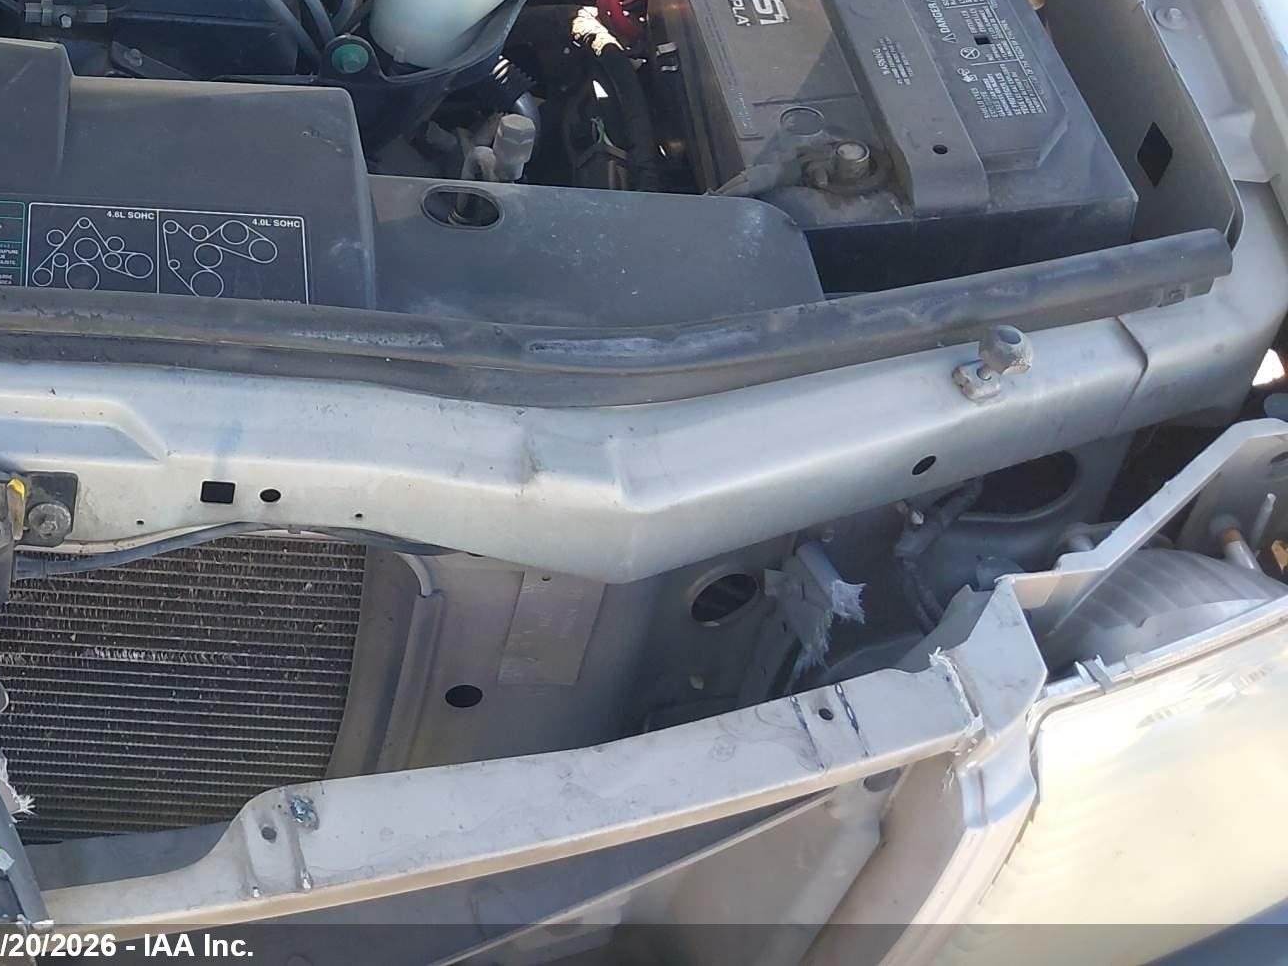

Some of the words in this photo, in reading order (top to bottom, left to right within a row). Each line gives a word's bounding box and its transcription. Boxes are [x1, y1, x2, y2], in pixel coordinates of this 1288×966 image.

[106, 210, 125, 218] 4.6L
[128, 211, 154, 220] SOHC
[252, 218, 270, 226] 4.0L
[272, 220, 300, 228] SOHC
